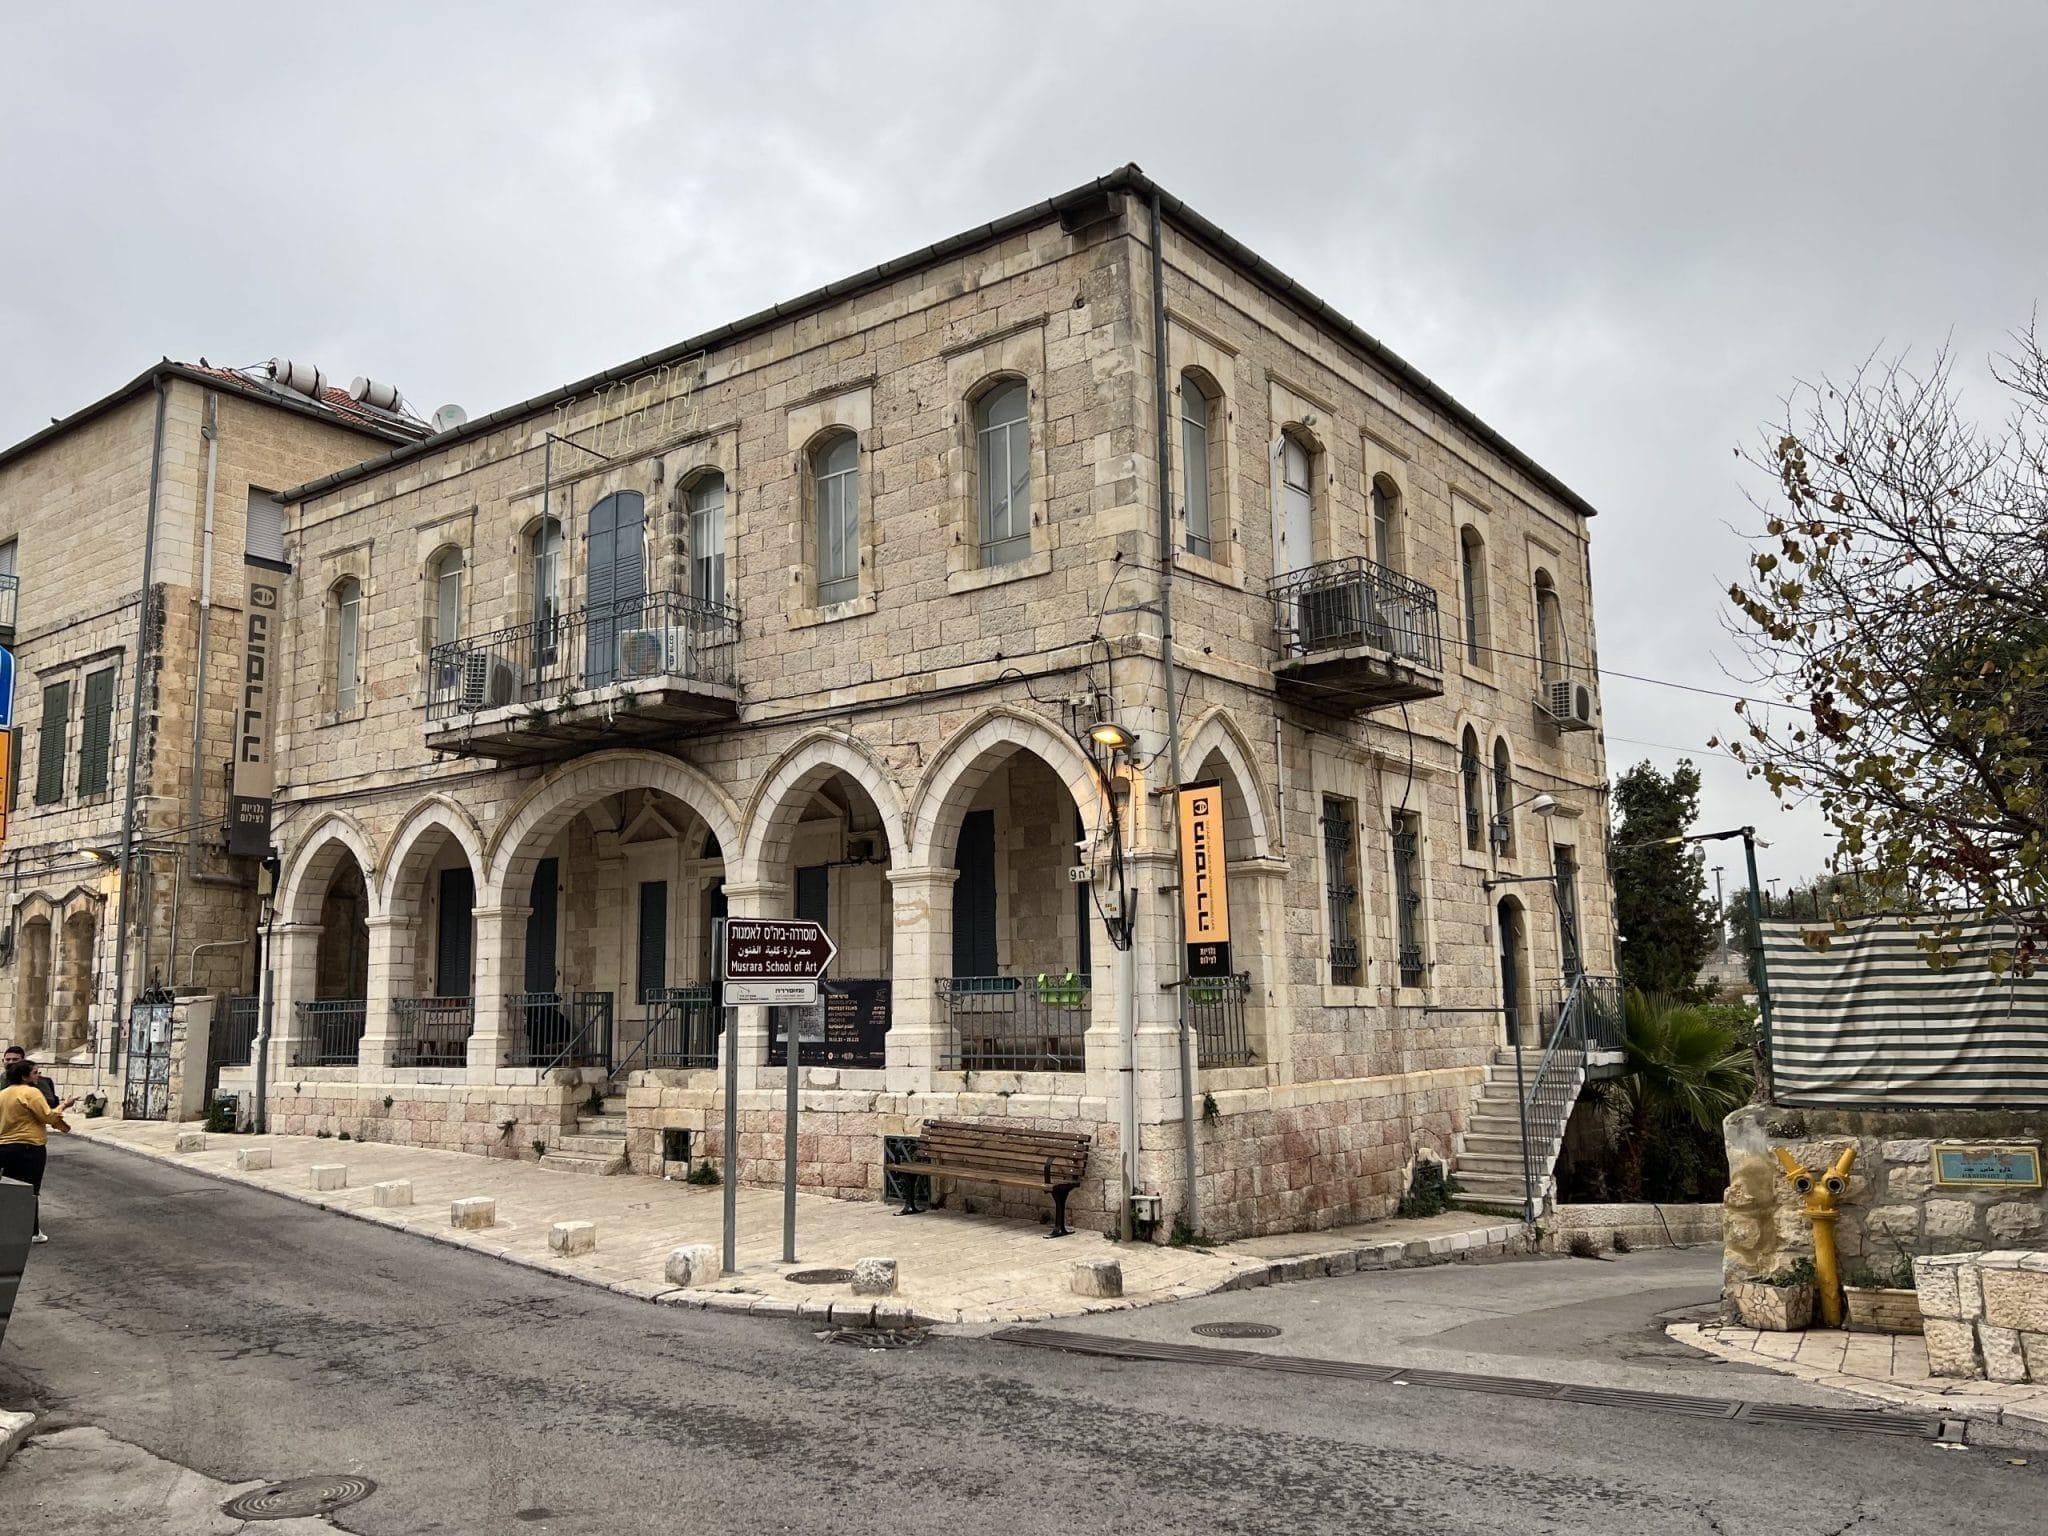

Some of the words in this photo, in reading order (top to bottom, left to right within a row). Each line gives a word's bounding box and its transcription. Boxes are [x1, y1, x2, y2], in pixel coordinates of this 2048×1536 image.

[551, 349, 706, 471] LIFE
[242, 613, 267, 763] מוסררה
[241, 803, 264, 813] גלריות
[240, 813, 264, 823] לצילום
[1193, 821, 1210, 932] מוסררה
[731, 923, 761, 939] לאמנות
[737, 945, 762, 957] الفنون
[731, 960, 763, 972] Musrara
[765, 960, 792, 972] School
[794, 960, 802, 972] of
[805, 960, 817, 972] Art
